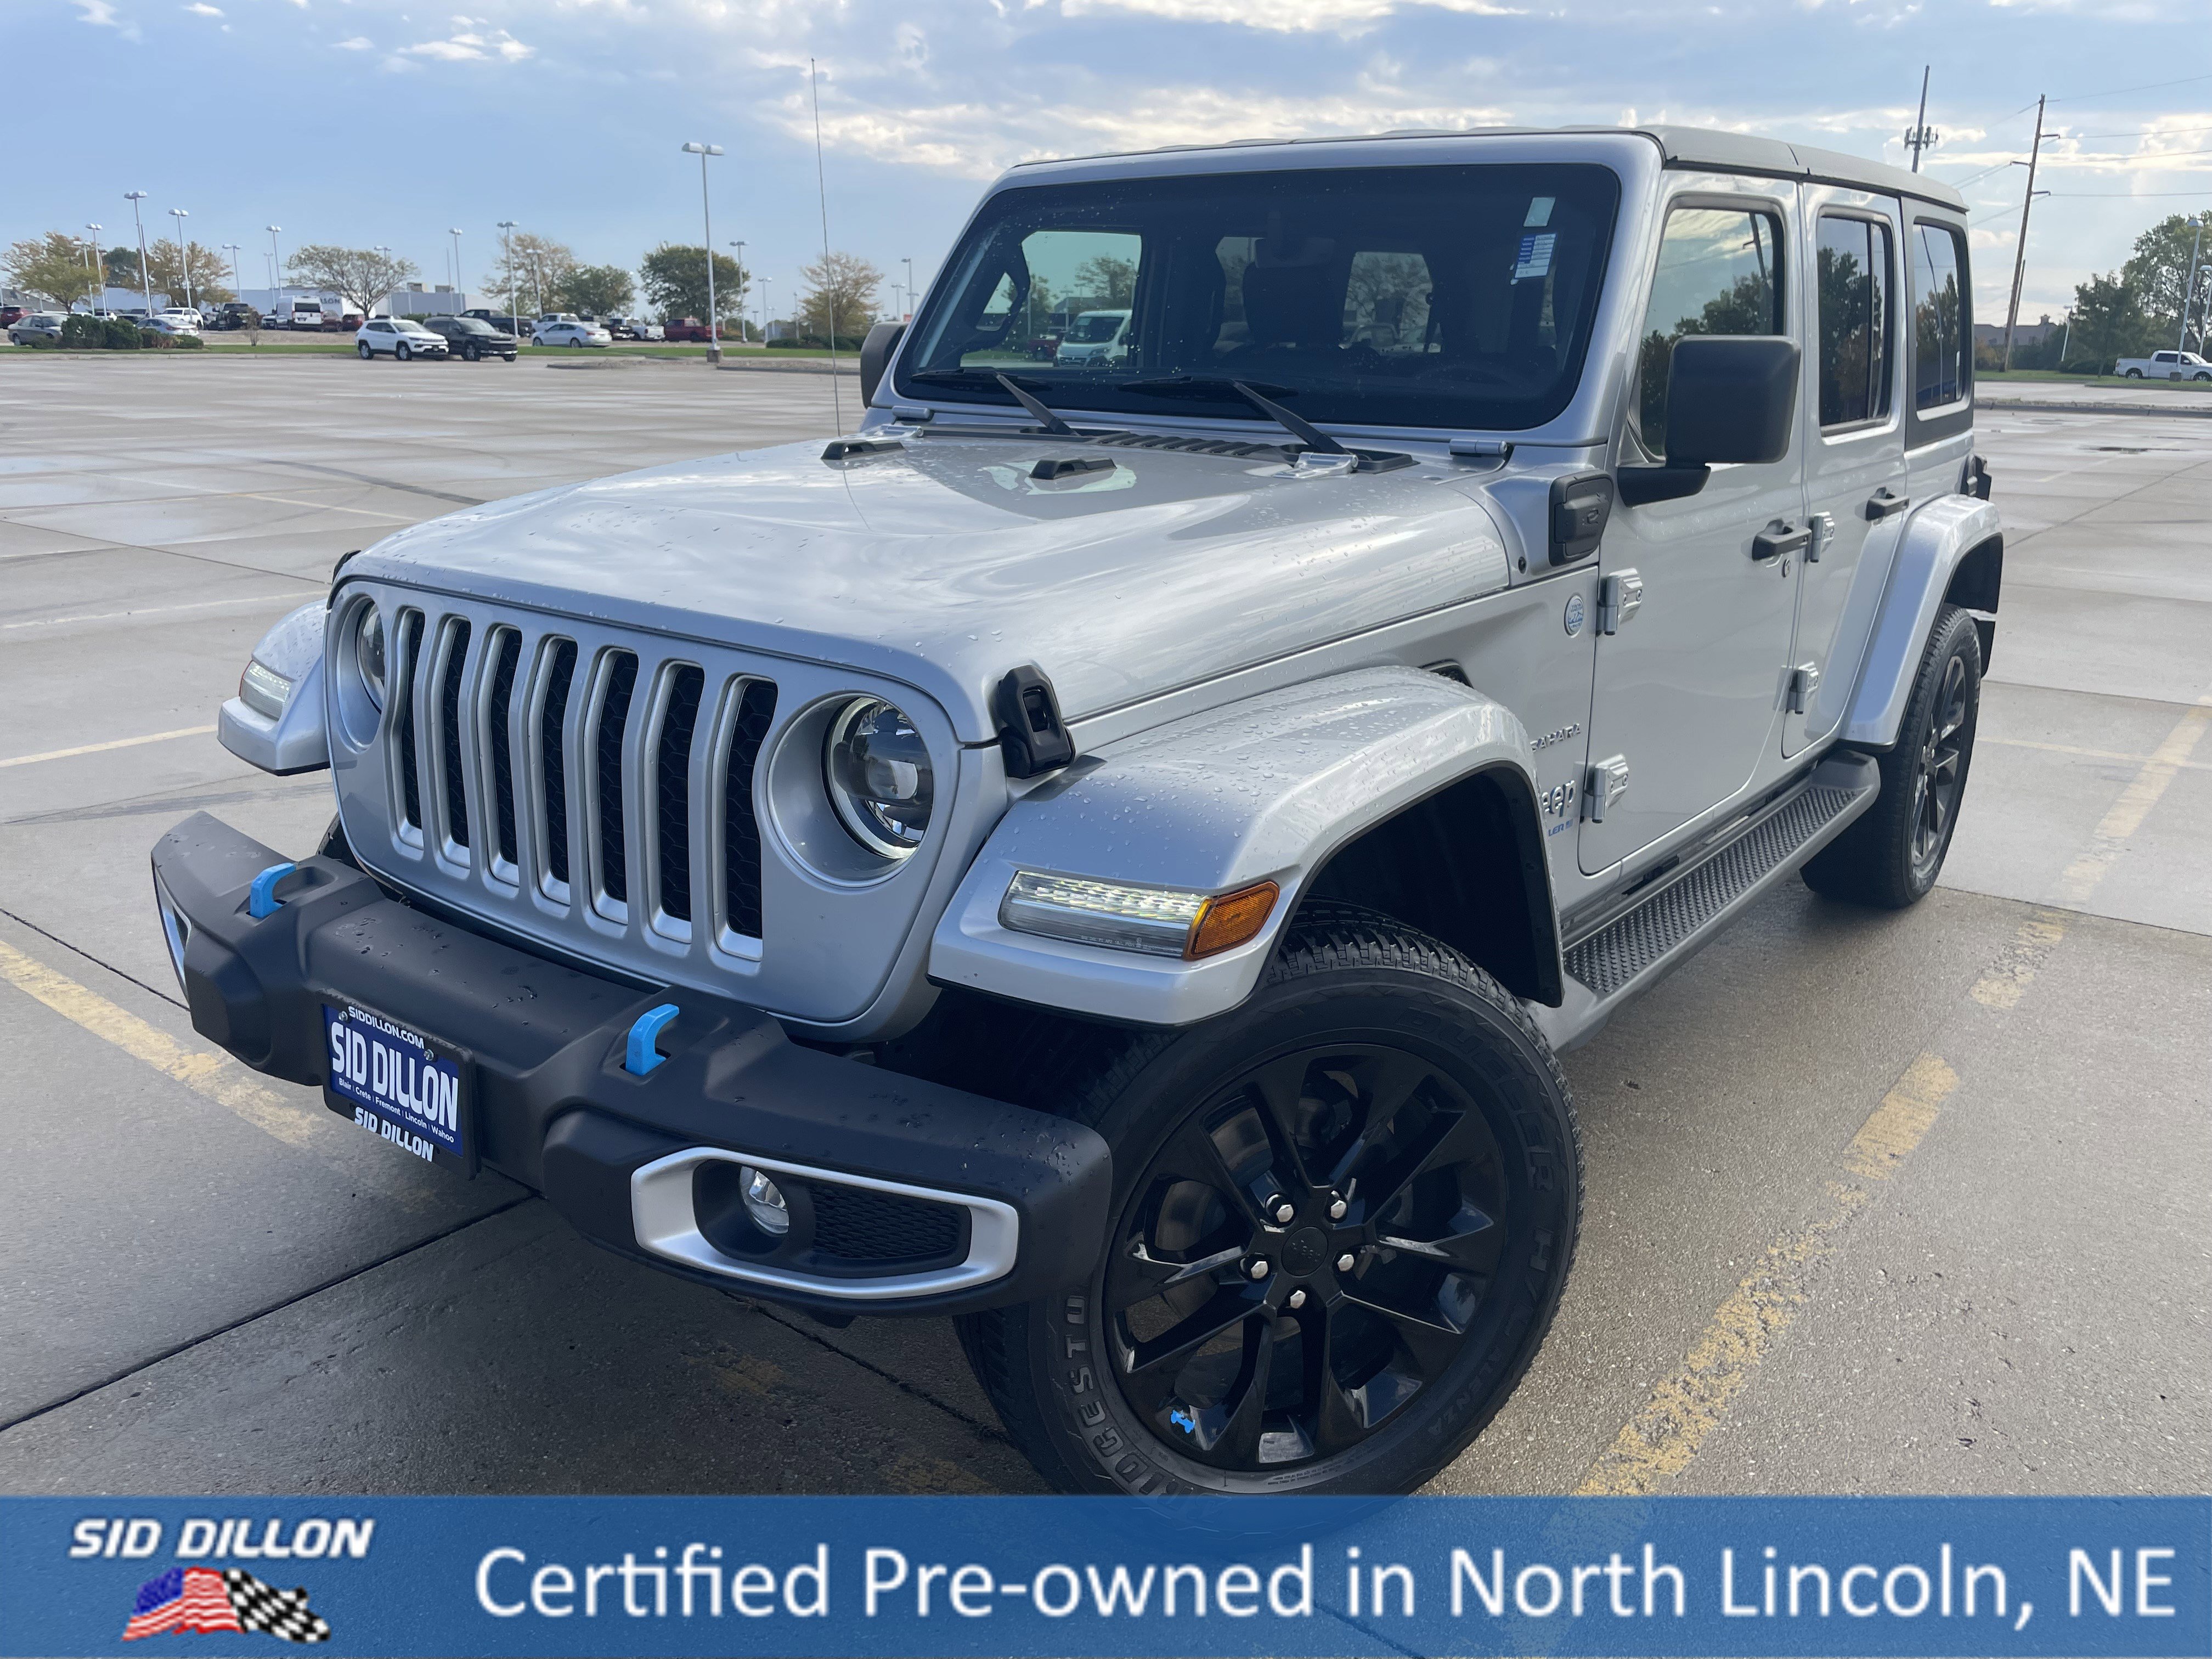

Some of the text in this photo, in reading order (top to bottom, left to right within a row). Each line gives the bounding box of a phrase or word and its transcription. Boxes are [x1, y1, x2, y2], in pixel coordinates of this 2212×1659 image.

[1530, 723, 1581, 752] SAHARA
[1542, 780, 1576, 818] eep
[1548, 823, 1564, 836] LER
[348, 1006, 425, 1050] SIDDILLON.COM
[331, 1022, 459, 1132] SID DILLON
[339, 1077, 454, 1143] Blair Crete Fremont Lincoln Wahoo
[354, 1107, 434, 1163] SID DILLON
